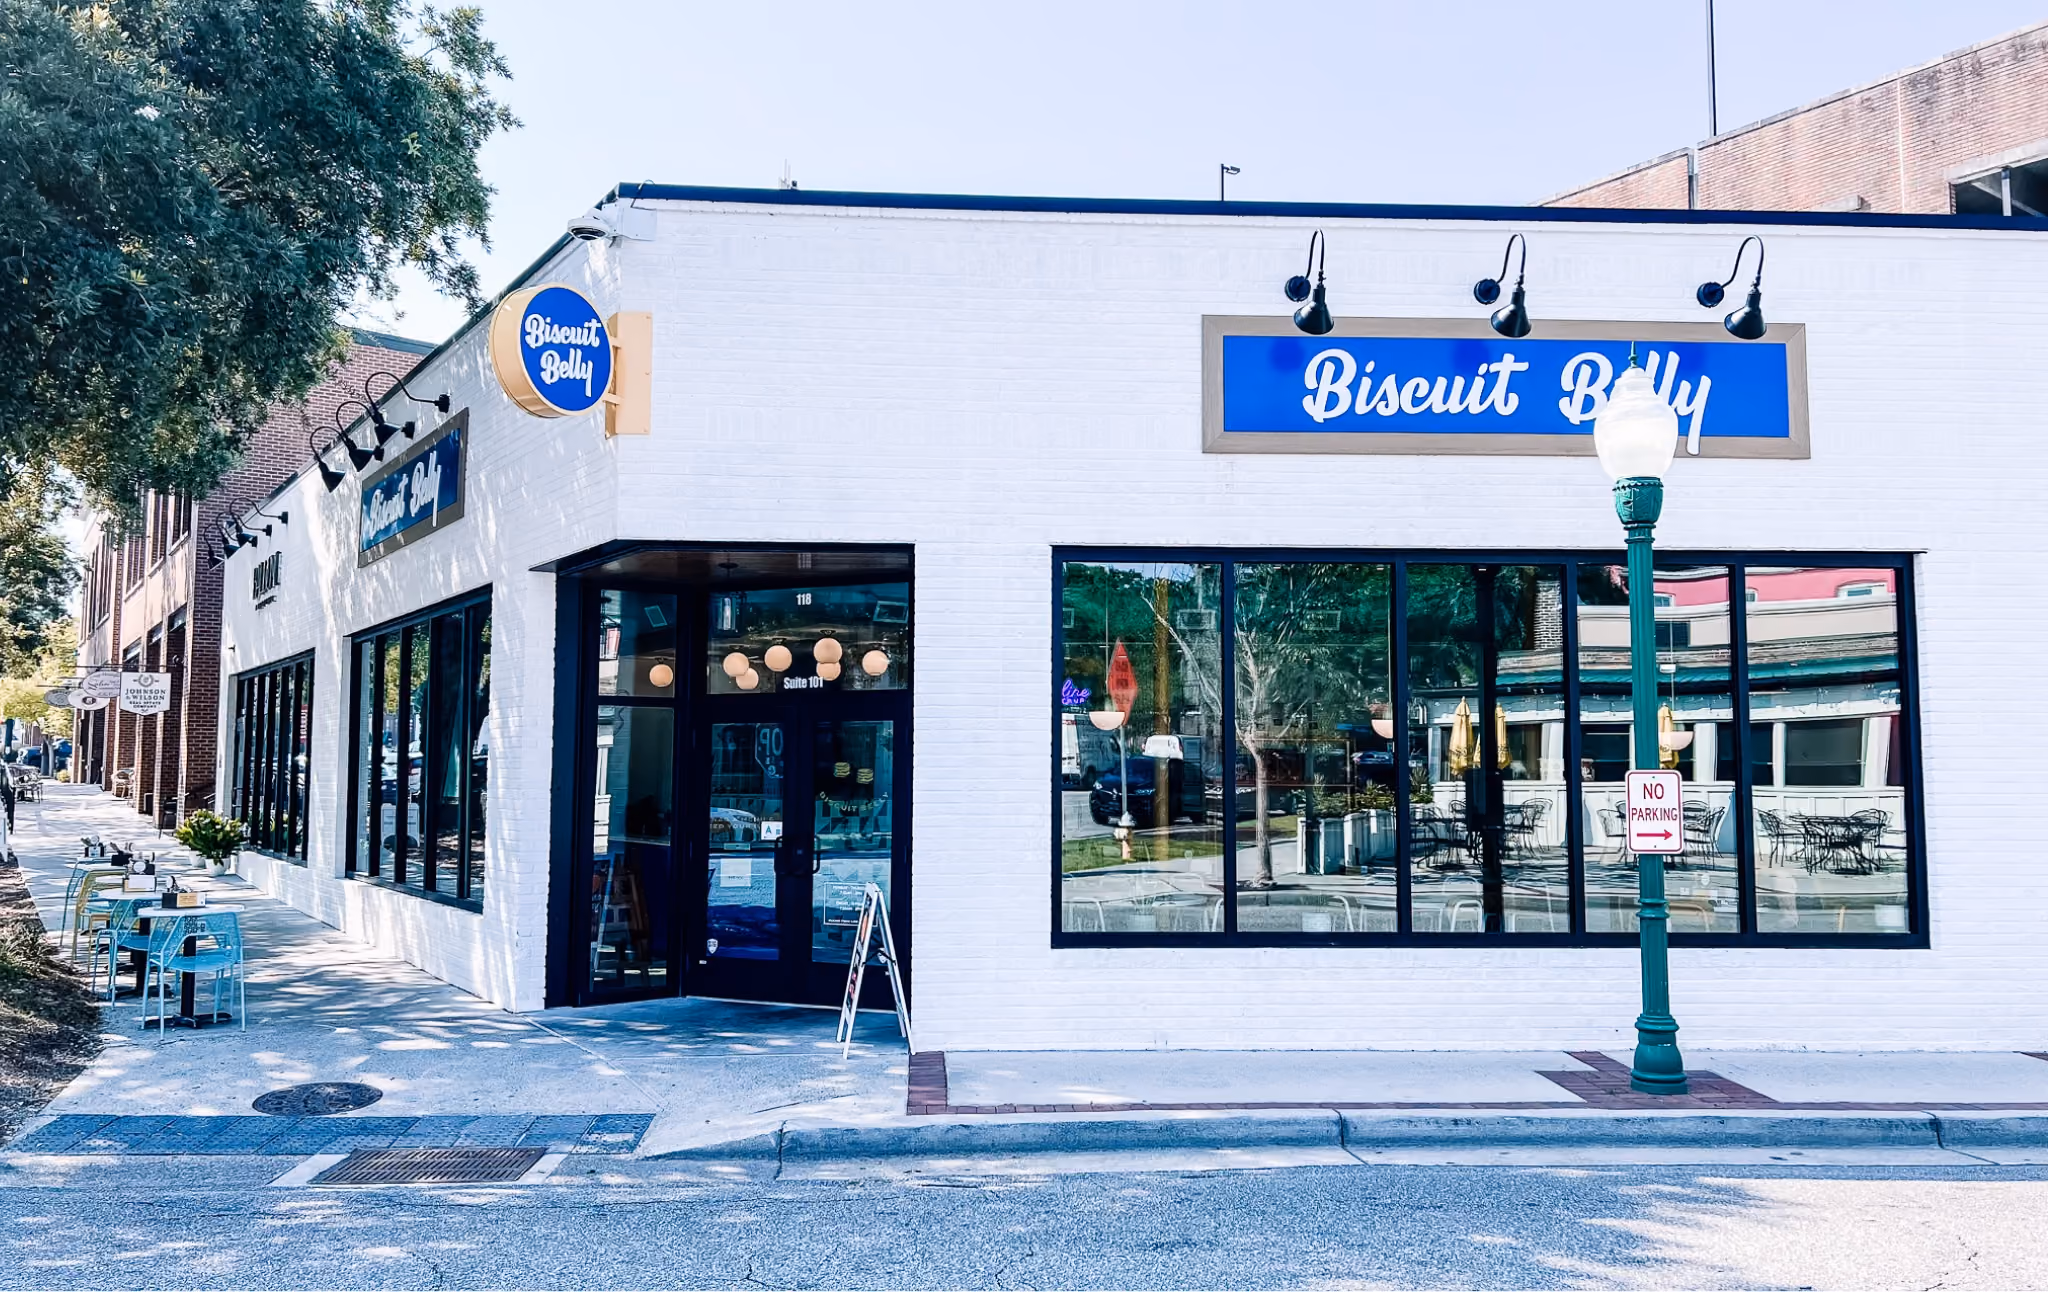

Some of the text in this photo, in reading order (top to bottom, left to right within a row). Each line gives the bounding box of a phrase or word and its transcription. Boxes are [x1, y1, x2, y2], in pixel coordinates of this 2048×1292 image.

[524, 313, 602, 349] Biscuit
[540, 348, 593, 397] Belly
[1302, 348, 1711, 455] Biscuit Blly
[370, 450, 442, 540] Biscuit Belly
[796, 593, 812, 605] 118
[783, 676, 823, 689] Suite 101
[1643, 783, 1664, 799] NO
[1631, 808, 1678, 821] PARKING
